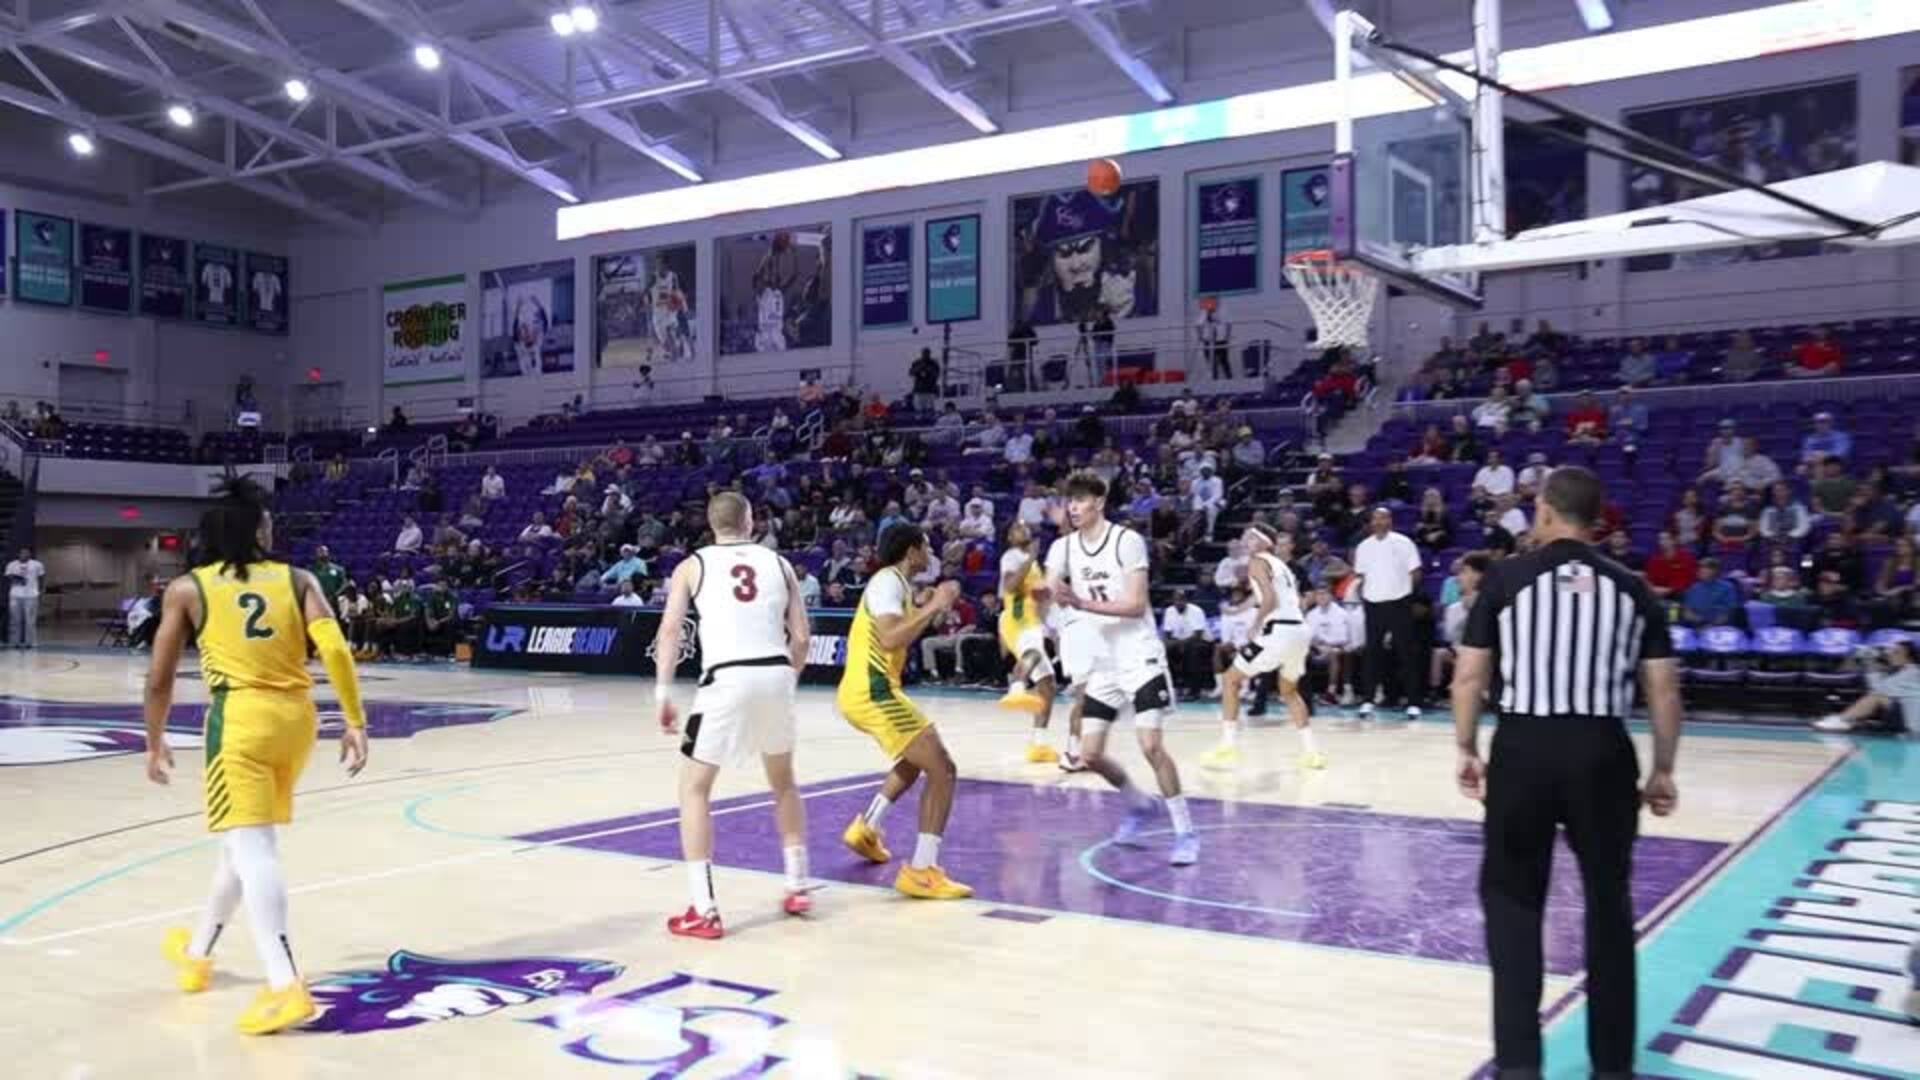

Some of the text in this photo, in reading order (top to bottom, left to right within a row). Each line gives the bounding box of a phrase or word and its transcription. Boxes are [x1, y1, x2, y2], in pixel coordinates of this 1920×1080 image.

[386, 302, 466, 328] CROWTHER
[393, 324, 459, 350] ROOFING
[729, 564, 759, 603] 3
[238, 591, 275, 639] 2
